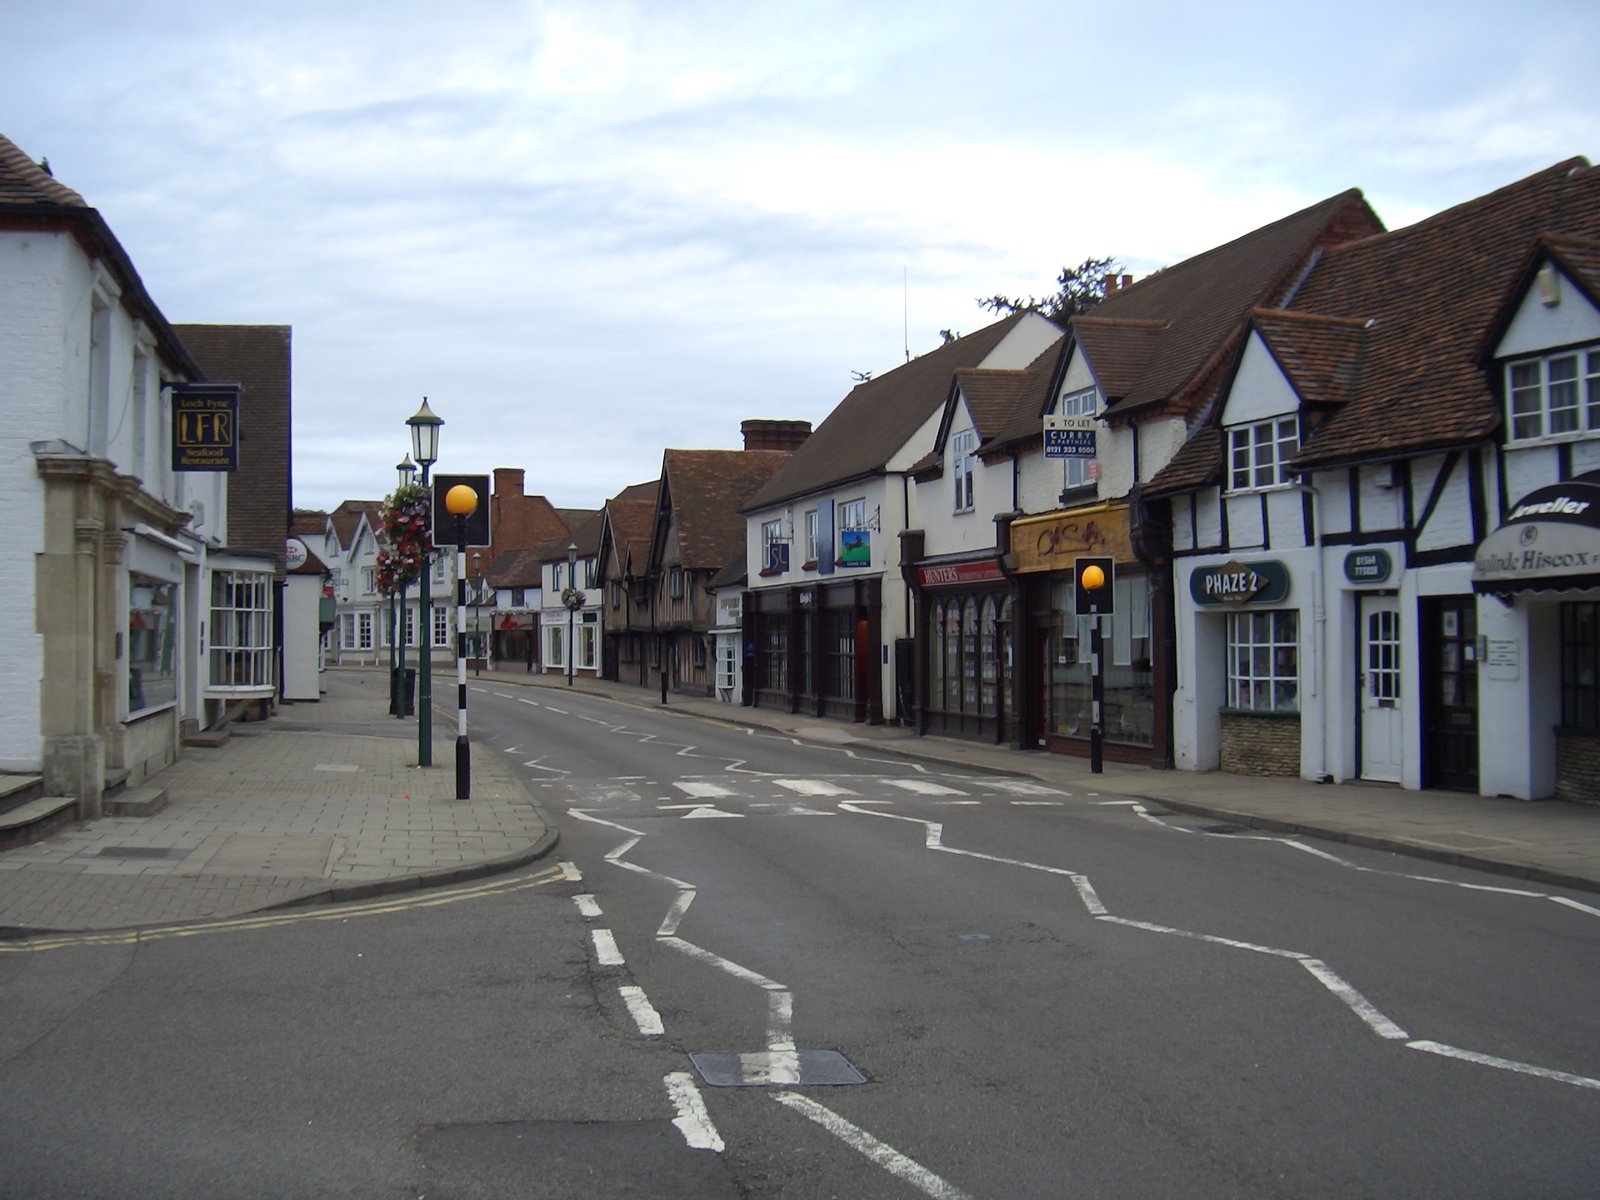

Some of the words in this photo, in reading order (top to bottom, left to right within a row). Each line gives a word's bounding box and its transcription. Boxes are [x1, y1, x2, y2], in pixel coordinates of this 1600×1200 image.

[181, 412, 230, 443] LFR
[1050, 430, 1091, 439] CURRY
[186, 448, 224, 456] Seafood
[181, 456, 229, 465] Restaurant
[286, 554, 305, 563] SBC
[1522, 550, 1589, 570] Hiscox
[924, 567, 958, 583] HUNTERS
[1205, 572, 1247, 594] PHAZE
[1249, 571, 1257, 592] 2
